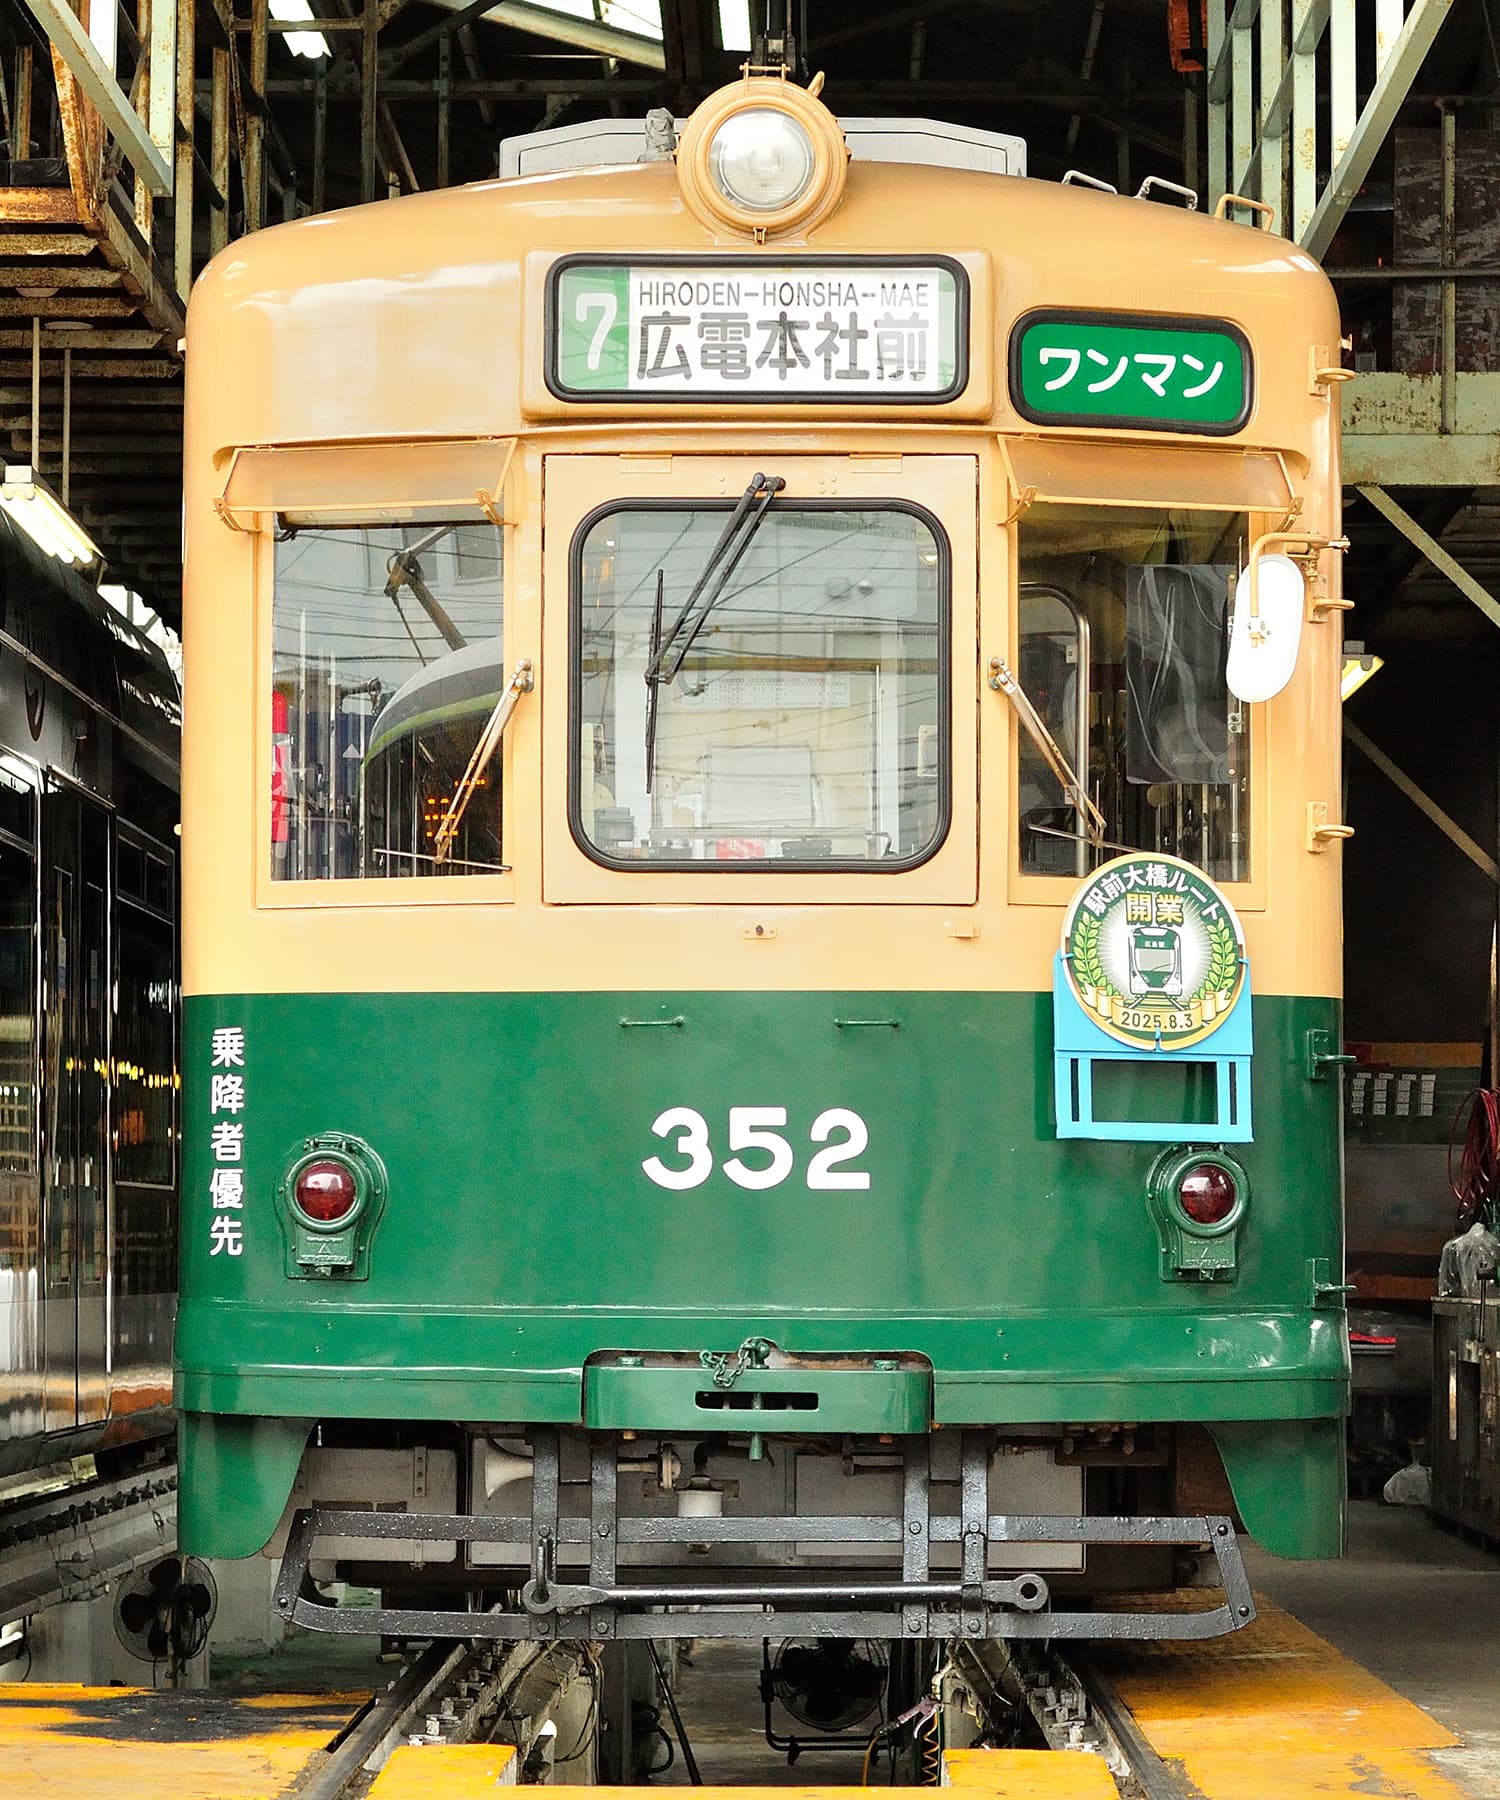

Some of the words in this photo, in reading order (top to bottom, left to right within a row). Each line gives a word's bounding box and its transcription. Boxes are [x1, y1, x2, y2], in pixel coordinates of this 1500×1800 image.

[575, 292, 619, 371] 7
[636, 311, 929, 382] 広電本社前
[1039, 347, 1224, 398] ワンマン
[1083, 863, 1220, 920] 駅前大橋ルート
[1125, 893, 1184, 924] 開業
[1121, 1011, 1193, 1029] 2025.8.3
[209, 1026, 246, 1257] 乗降者優先
[641, 1106, 872, 1191] 352
